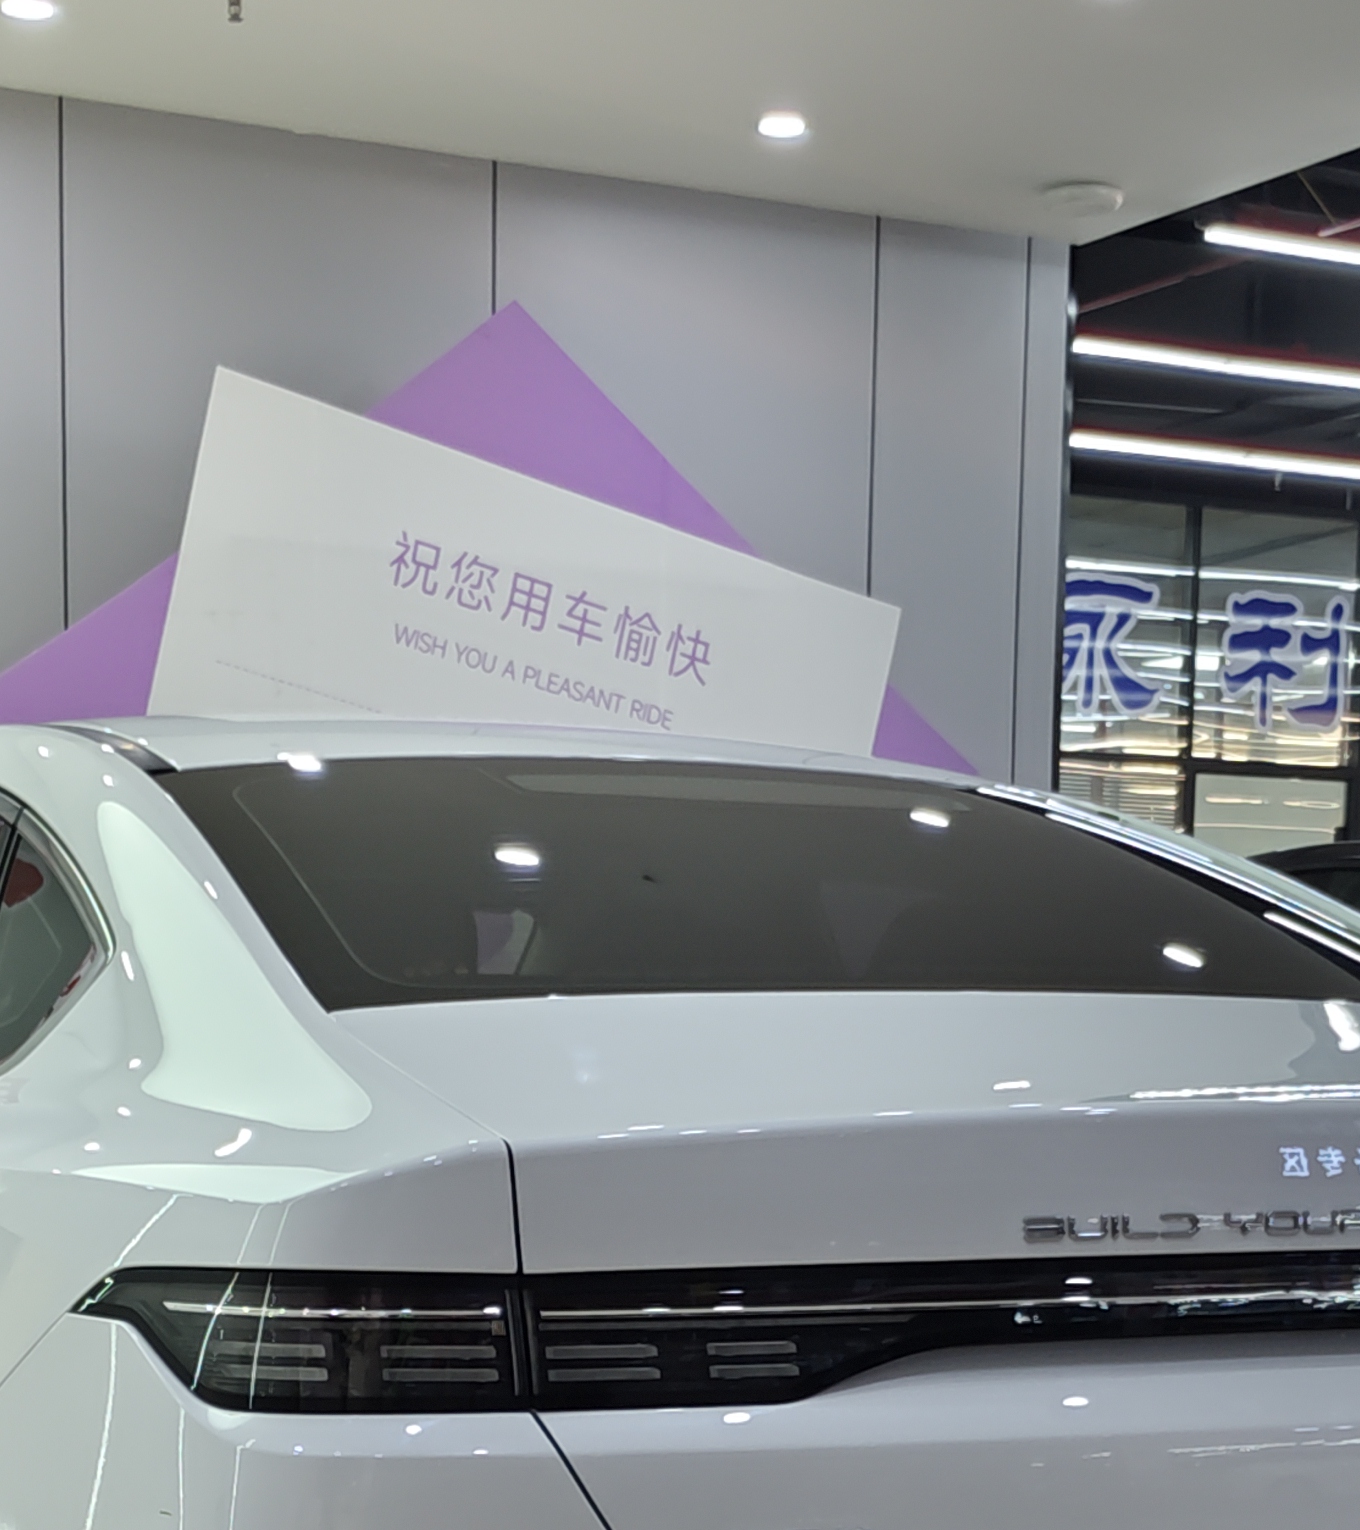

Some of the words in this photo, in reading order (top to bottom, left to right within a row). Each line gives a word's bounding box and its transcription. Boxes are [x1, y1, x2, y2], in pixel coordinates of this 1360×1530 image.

[389, 530, 712, 686] 祝您用车愉快
[393, 622, 448, 660] WISH
[455, 642, 498, 675] YOU
[501, 660, 517, 681] A
[522, 665, 627, 714] PLEASANT
[629, 699, 675, 731] RIDE
[1022, 1213, 1198, 1243] BUILD
